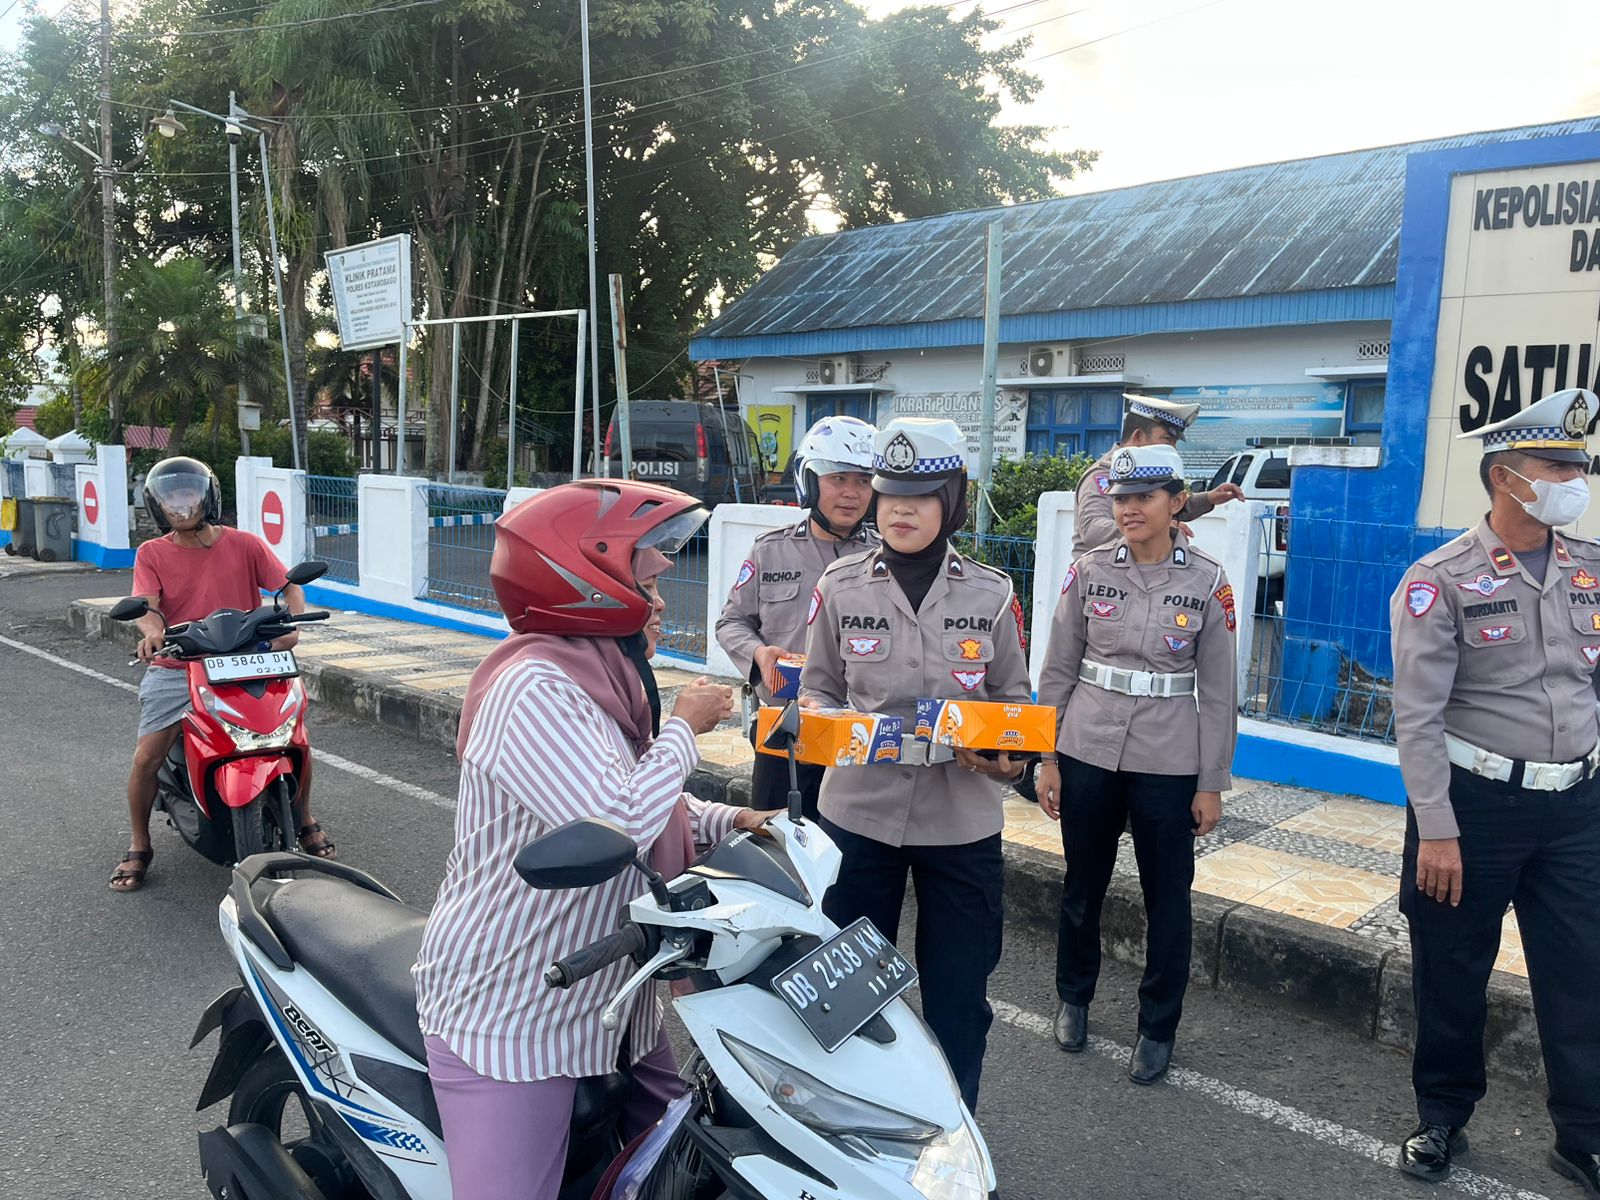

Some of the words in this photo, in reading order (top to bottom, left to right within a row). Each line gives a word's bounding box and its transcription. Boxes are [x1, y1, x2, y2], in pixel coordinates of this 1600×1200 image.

[345, 271, 366, 284] KLINIK
[366, 264, 397, 280] PRATAMA
[346, 283, 364, 293] POLRES
[895, 396, 932, 413] IKRAR
[934, 393, 1003, 413] POLANTS
[1087, 583, 1128, 601] LEDY
[1163, 595, 1206, 612] POLRI
[841, 615, 890, 631] FARA
[944, 616, 993, 633] POLRI
[207, 658, 225, 670] DB
[231, 655, 265, 667] 5840
[1003, 704, 1022, 714] thank
[781, 972, 819, 1010] DB
[812, 942, 863, 990] 2438
[853, 924, 887, 958] KM
